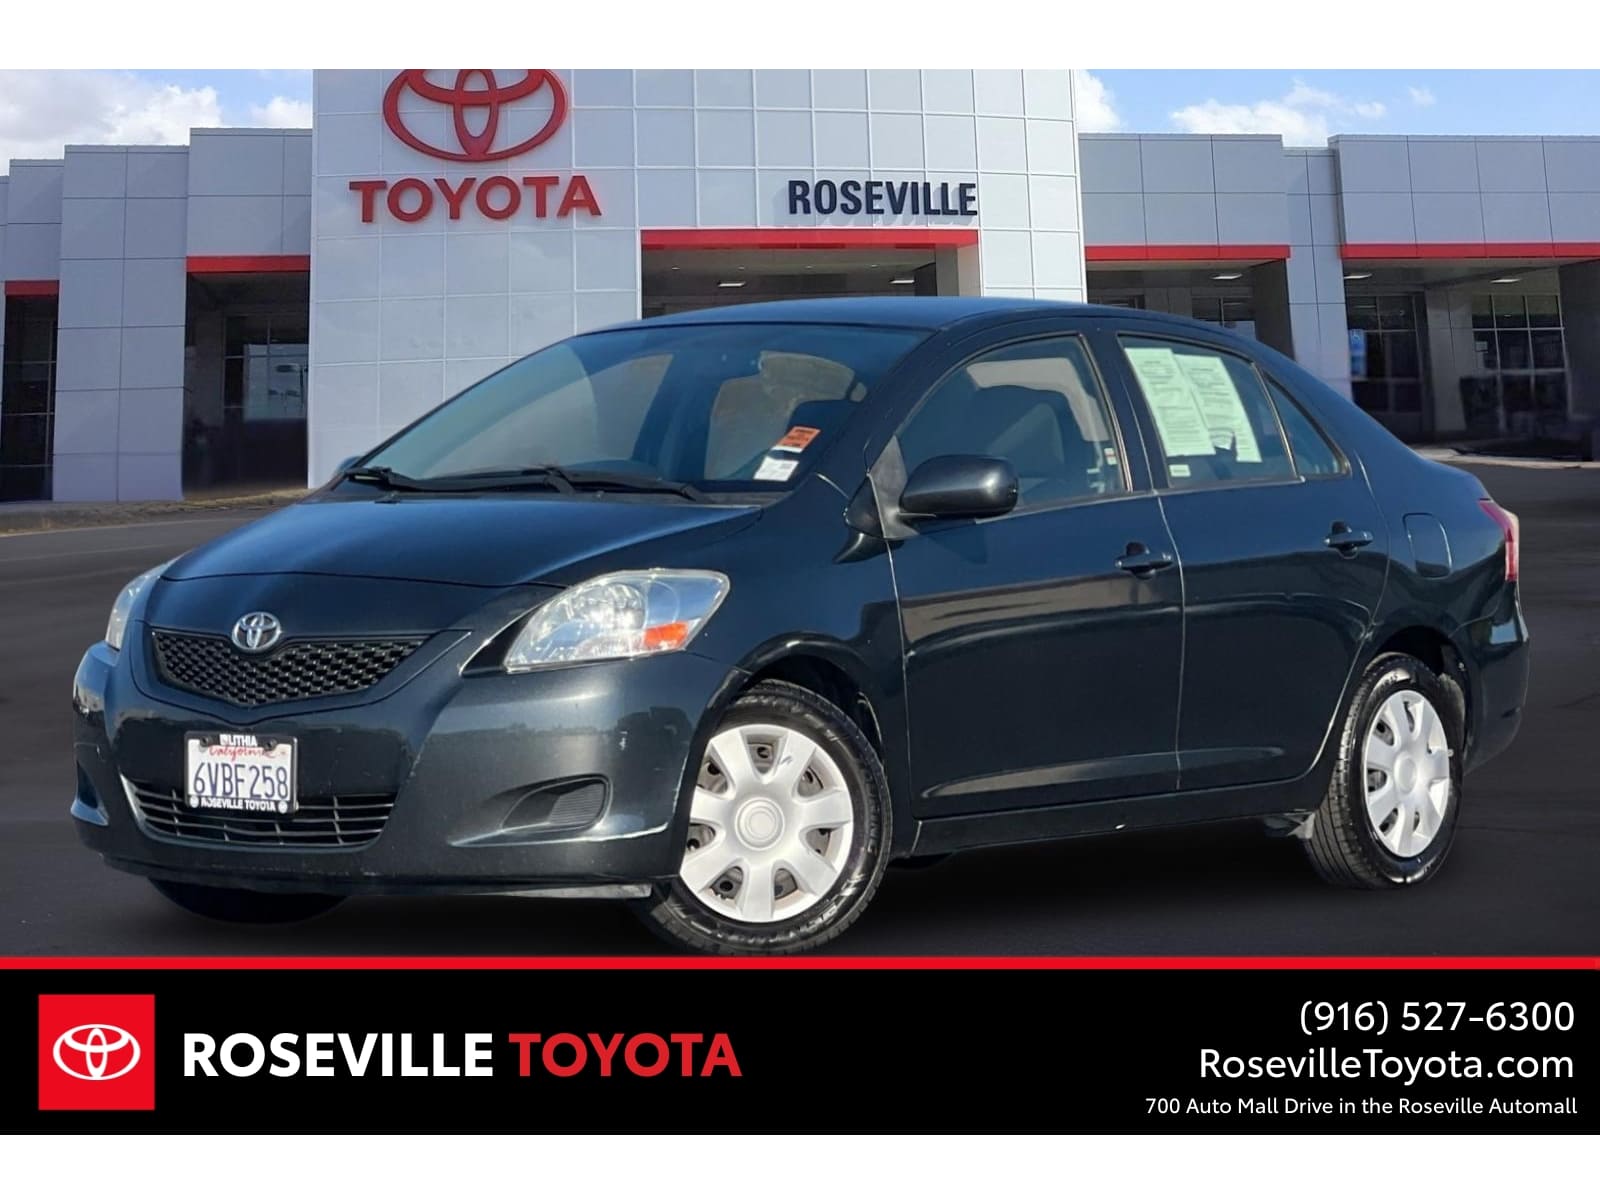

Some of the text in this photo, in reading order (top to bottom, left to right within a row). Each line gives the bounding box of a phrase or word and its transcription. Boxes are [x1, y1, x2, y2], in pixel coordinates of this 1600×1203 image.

[349, 175, 602, 224] TOYOTA
[788, 180, 978, 216] ROSEVILLE
[229, 734, 258, 746] LITHIA
[193, 762, 289, 800] 6VBF258
[200, 797, 277, 812] ROSEVILLE TOYOTA
